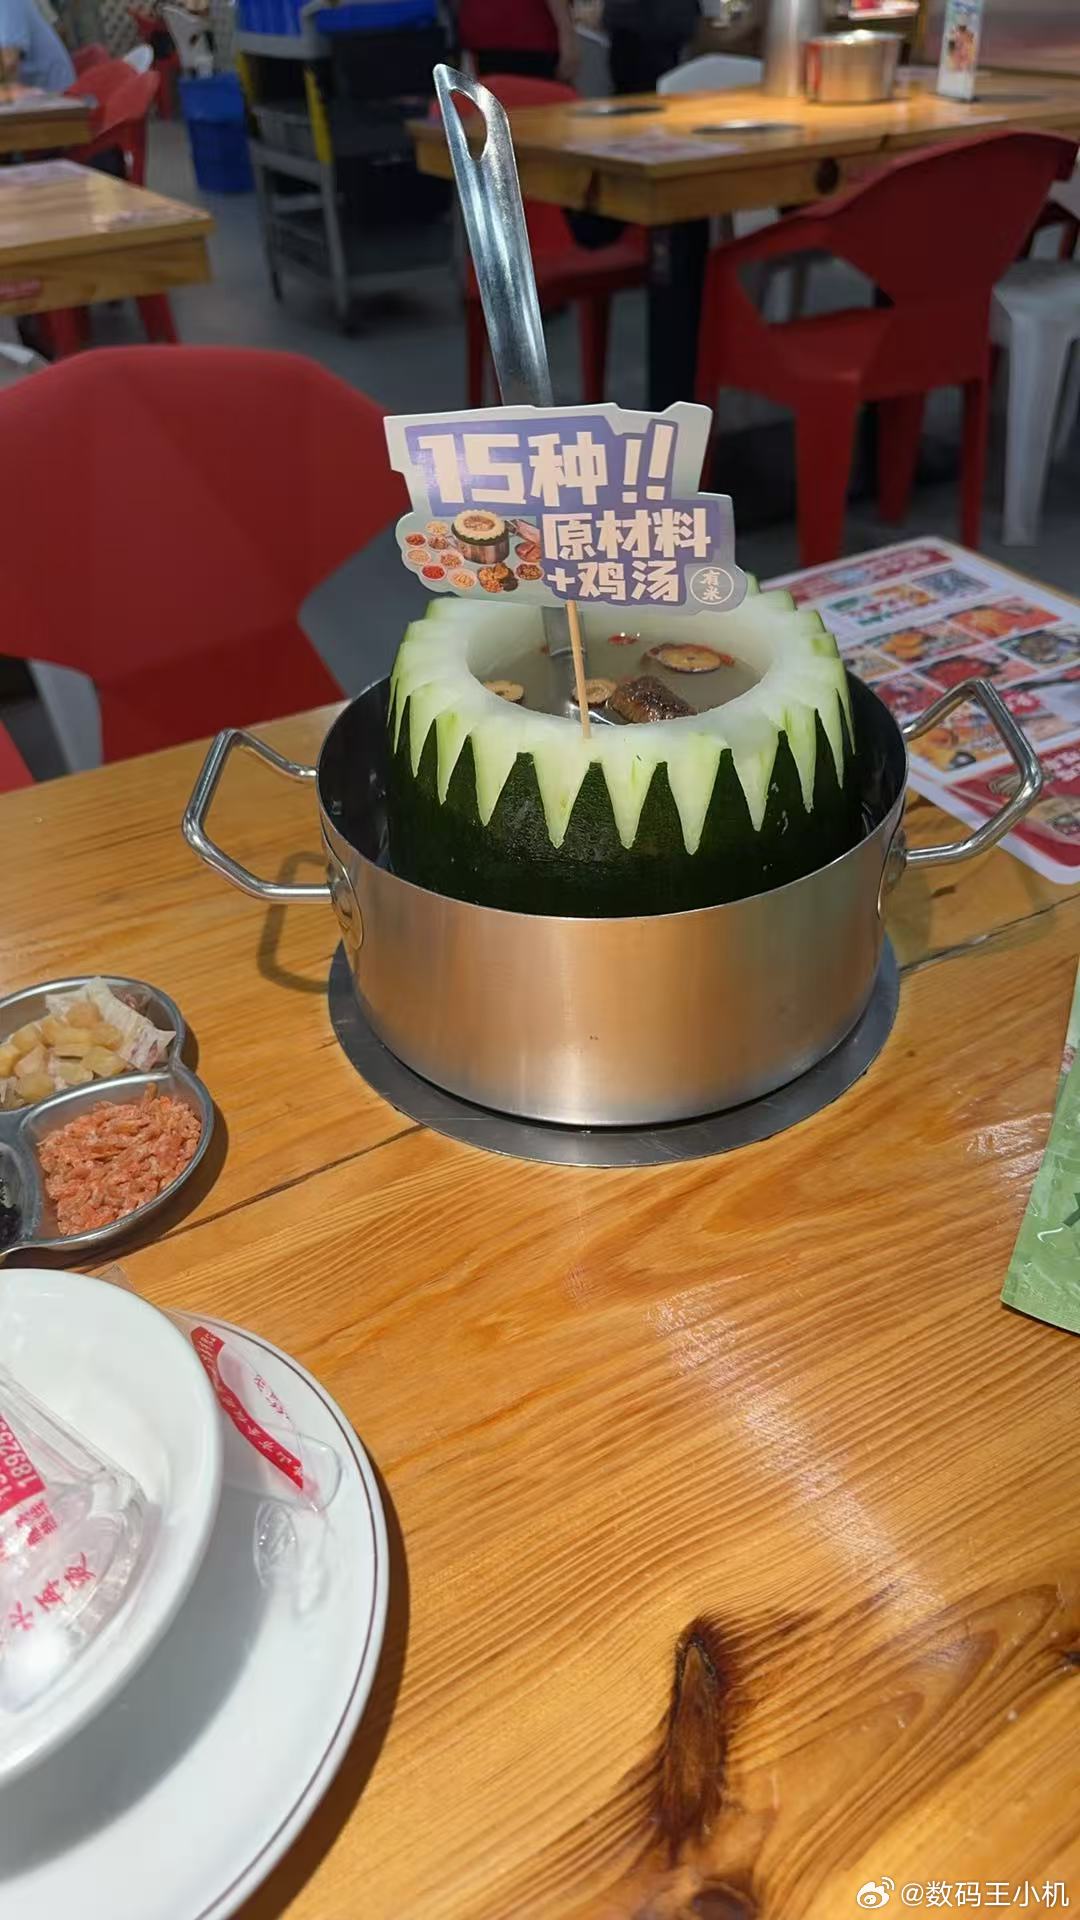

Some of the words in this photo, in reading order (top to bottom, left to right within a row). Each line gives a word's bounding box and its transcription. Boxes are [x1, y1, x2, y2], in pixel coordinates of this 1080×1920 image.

[542, 508, 711, 561] 原材料
[547, 560, 679, 602] +鸡汤
